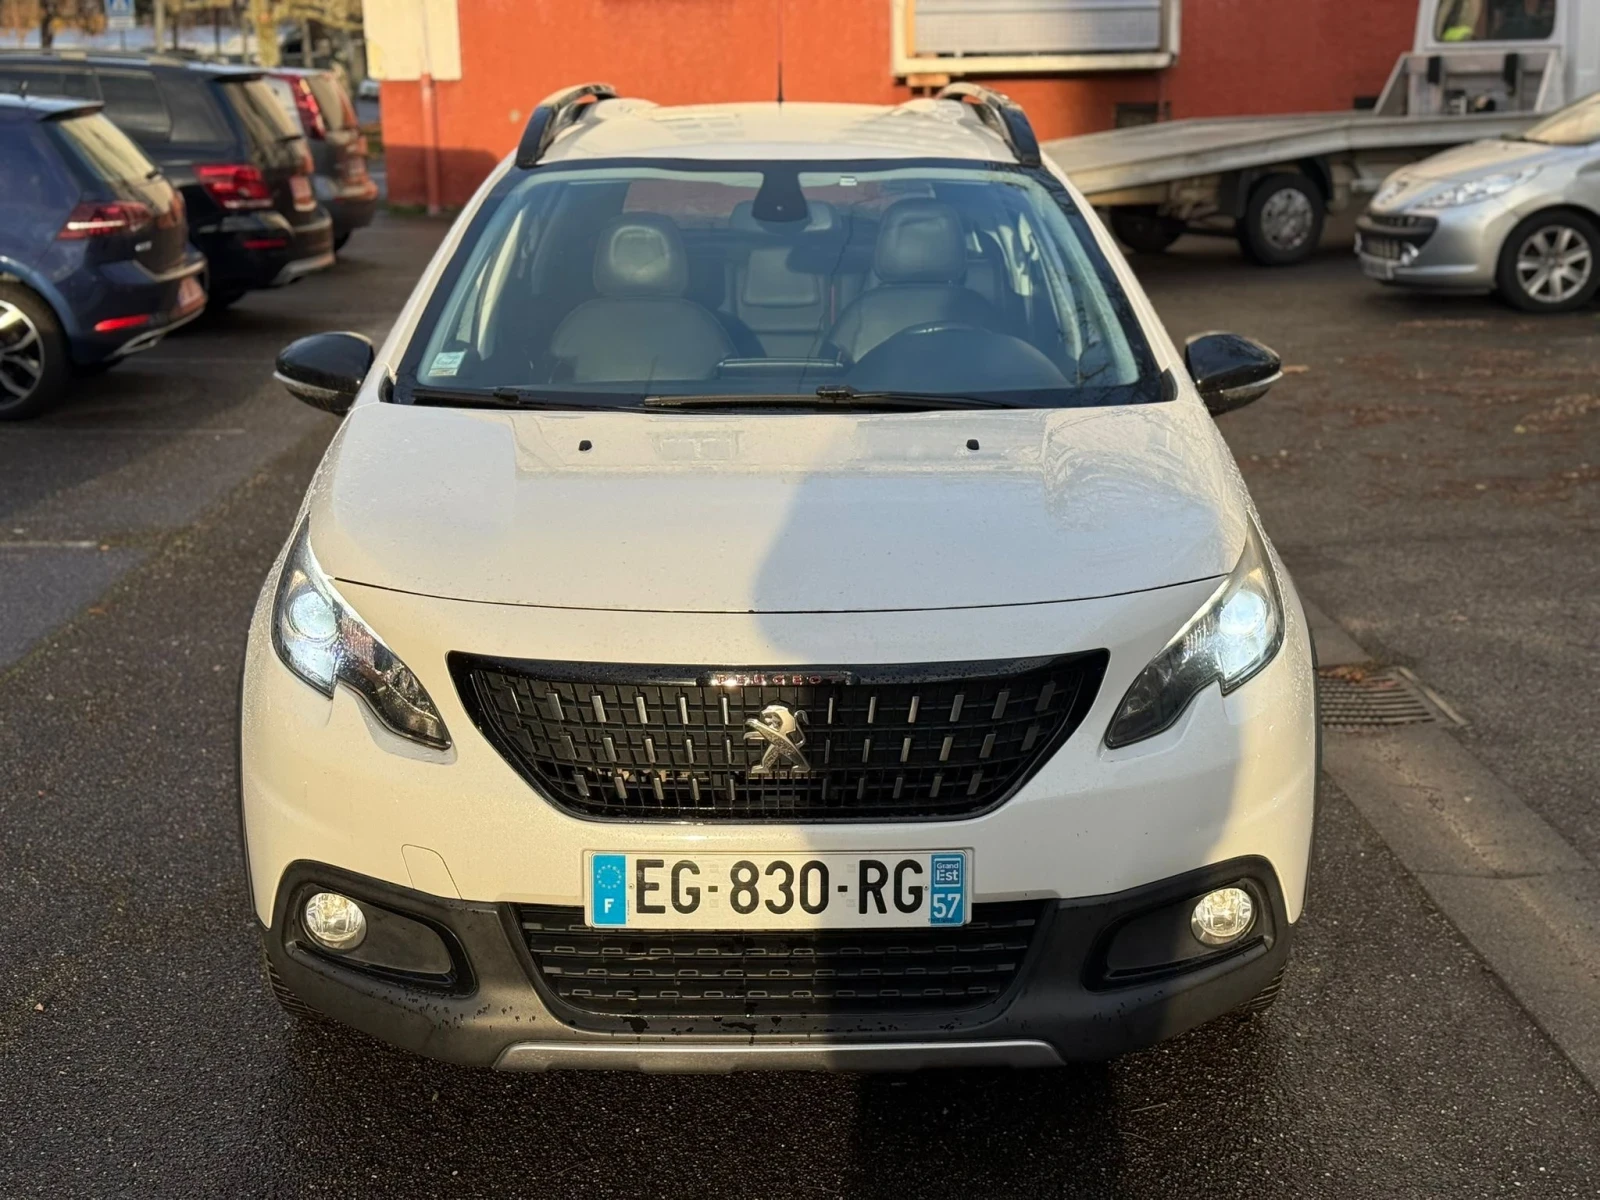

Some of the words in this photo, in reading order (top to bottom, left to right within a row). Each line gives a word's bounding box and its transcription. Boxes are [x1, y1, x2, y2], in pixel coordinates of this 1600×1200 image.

[936, 869, 959, 881] Est
[636, 859, 924, 915] EG-830-RG
[604, 898, 615, 914] F
[933, 893, 961, 919] 57
